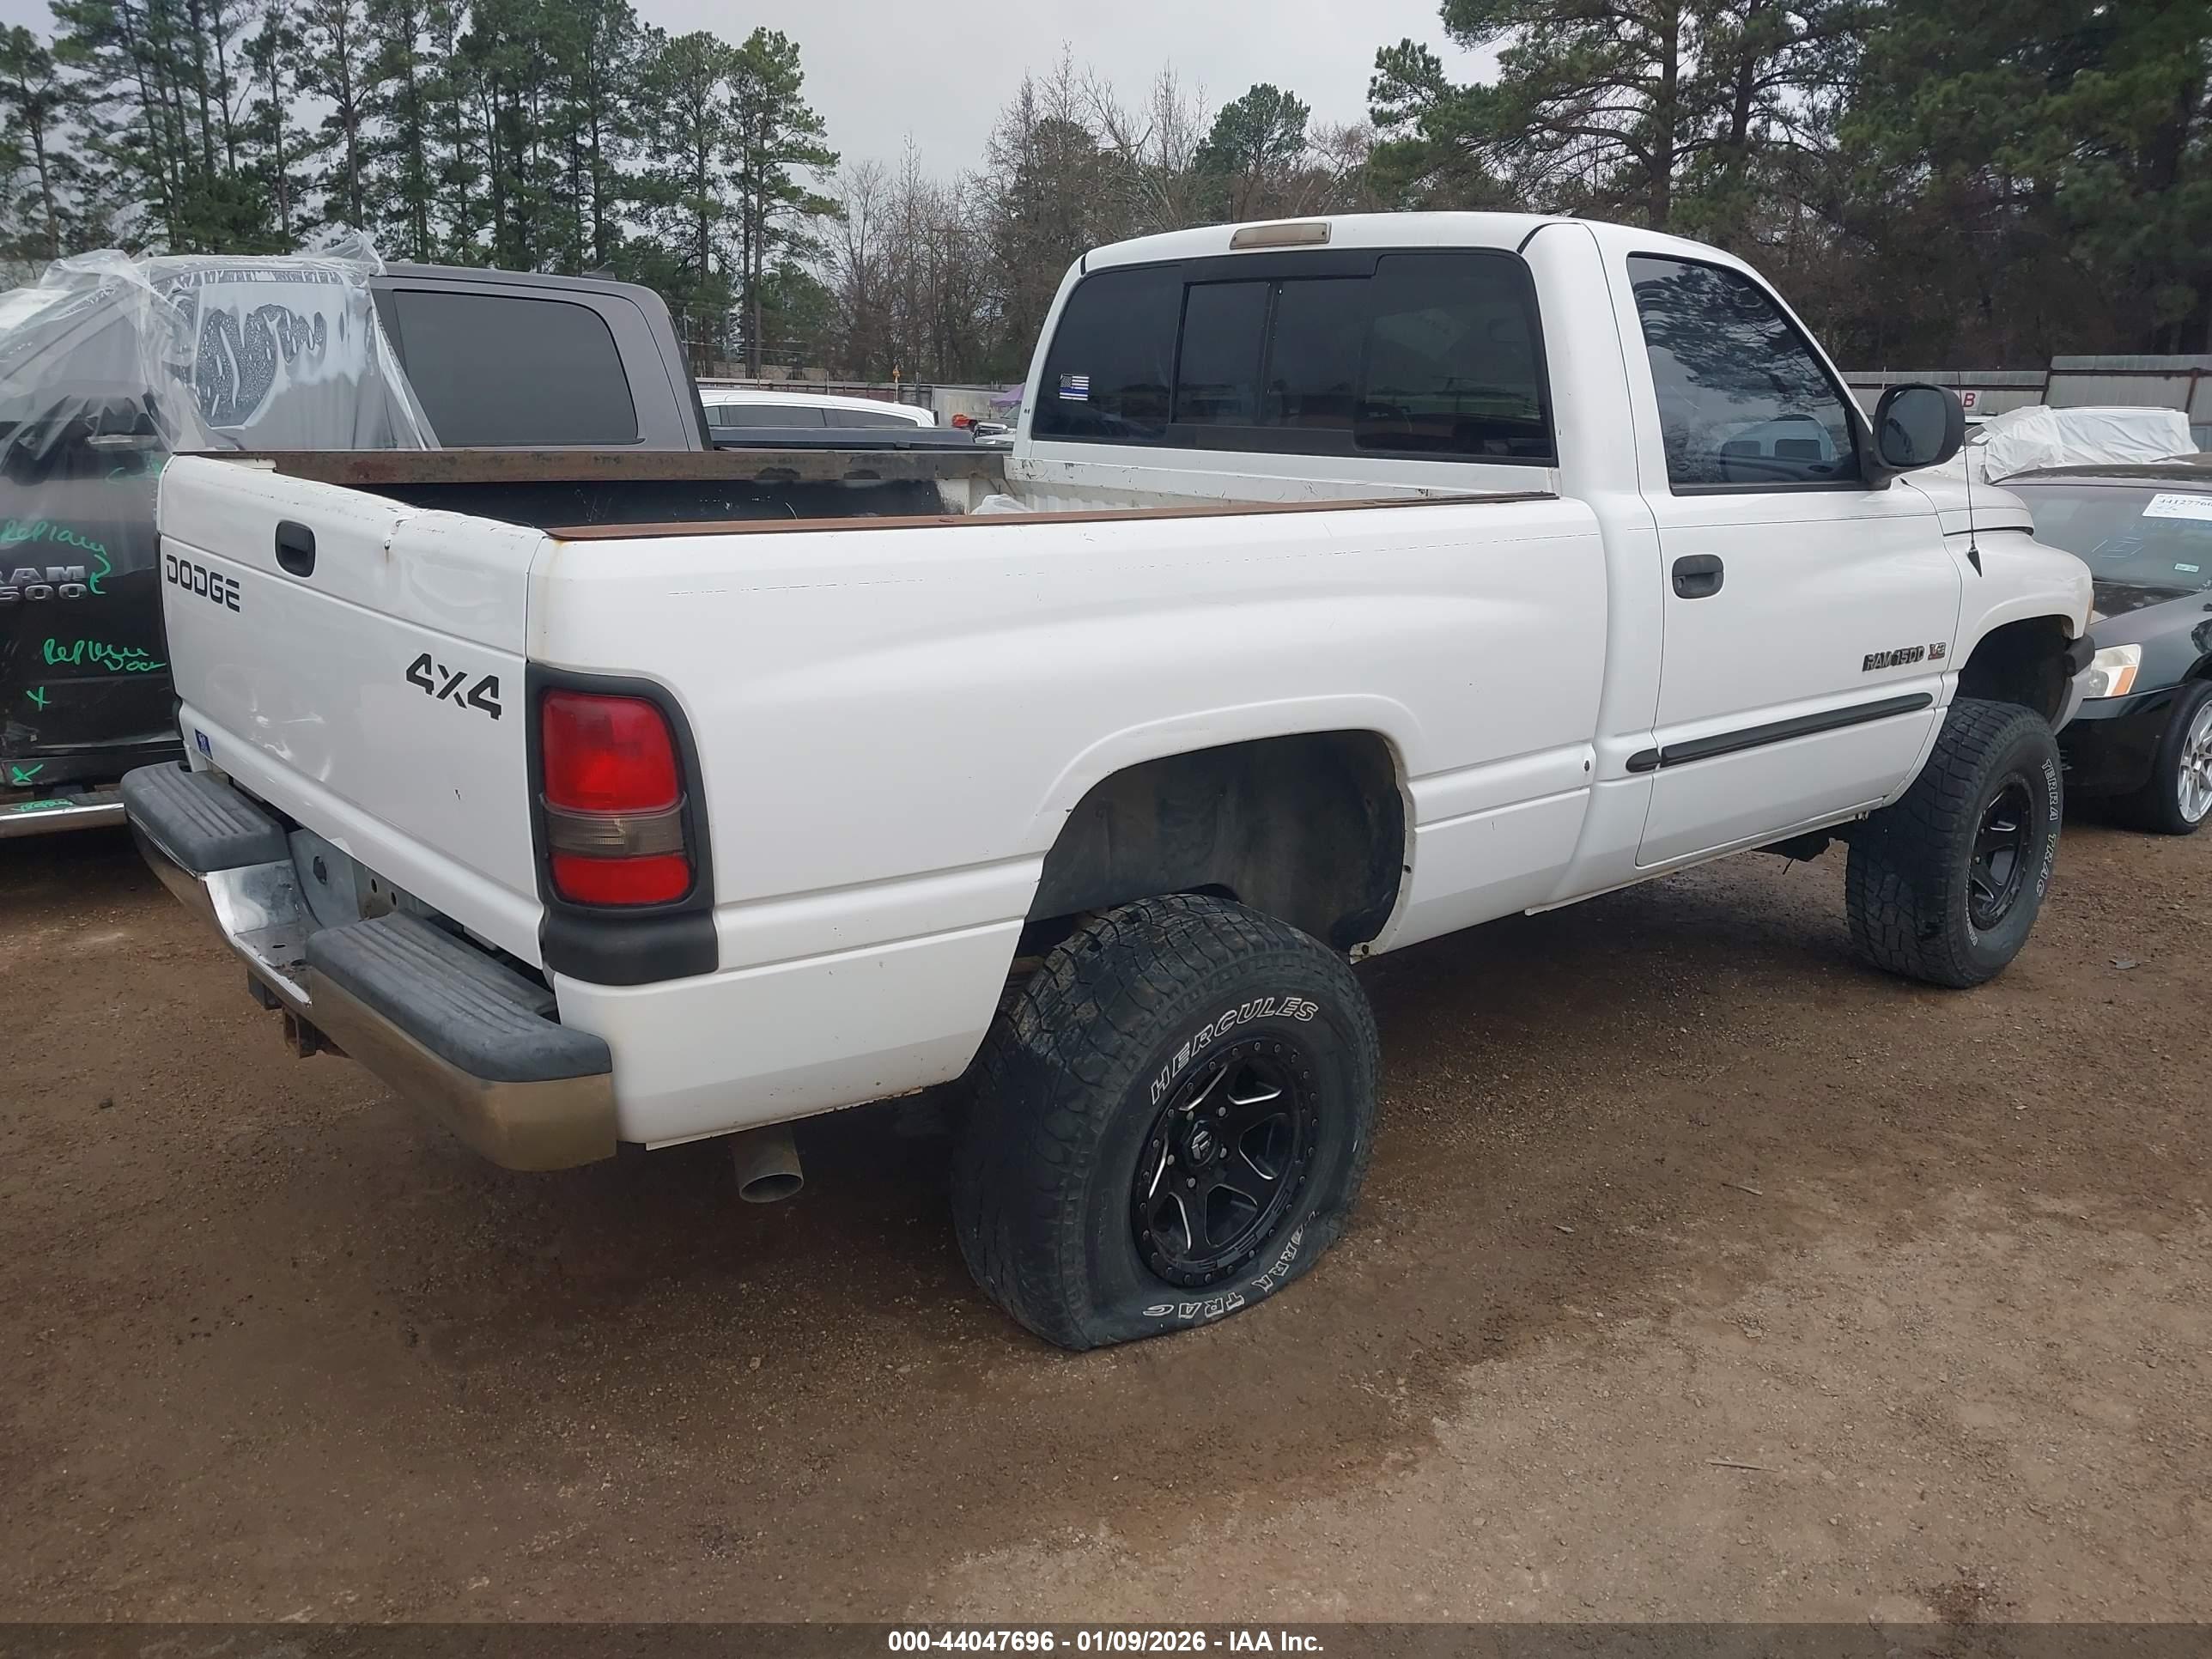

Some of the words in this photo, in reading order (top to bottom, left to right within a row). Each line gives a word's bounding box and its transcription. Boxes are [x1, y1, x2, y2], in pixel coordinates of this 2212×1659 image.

[1963, 392, 1976, 408] B
[166, 554, 240, 613] DODGE
[1862, 651, 1893, 672] RAM
[1892, 646, 1924, 666] 1500
[2040, 757, 2059, 822] TERRA
[2036, 832, 2057, 898] TRAC
[1151, 996, 1319, 1106] HERCULES
[1142, 1291, 1245, 1320] TRAC
